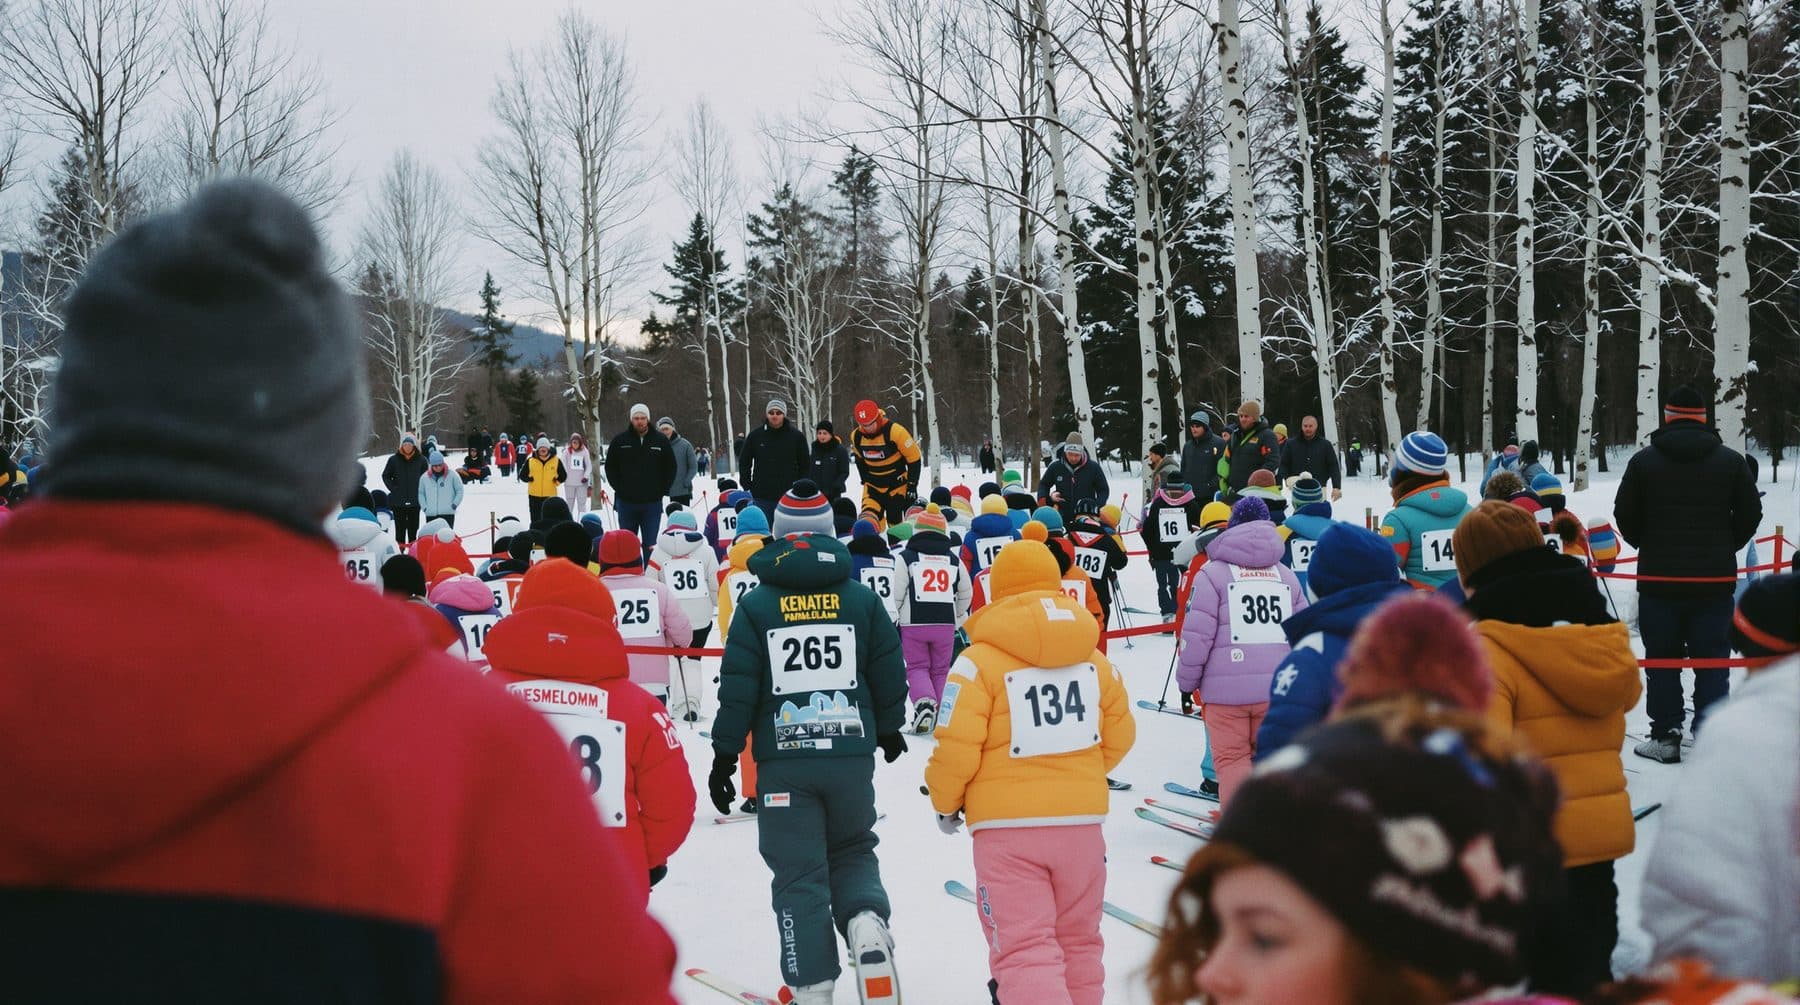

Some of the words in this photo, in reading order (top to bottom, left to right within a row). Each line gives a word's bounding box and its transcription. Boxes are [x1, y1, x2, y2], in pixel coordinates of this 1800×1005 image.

[1163, 521, 1178, 535] 16
[1300, 546, 1316, 563] 2
[673, 570, 698, 590] 36
[867, 576, 890, 598] 13
[922, 569, 949, 592] 29
[620, 600, 650, 625] 25
[780, 593, 840, 612] KENATER
[1241, 594, 1282, 625] 385
[782, 635, 842, 672] 265
[1024, 680, 1086, 727] 134
